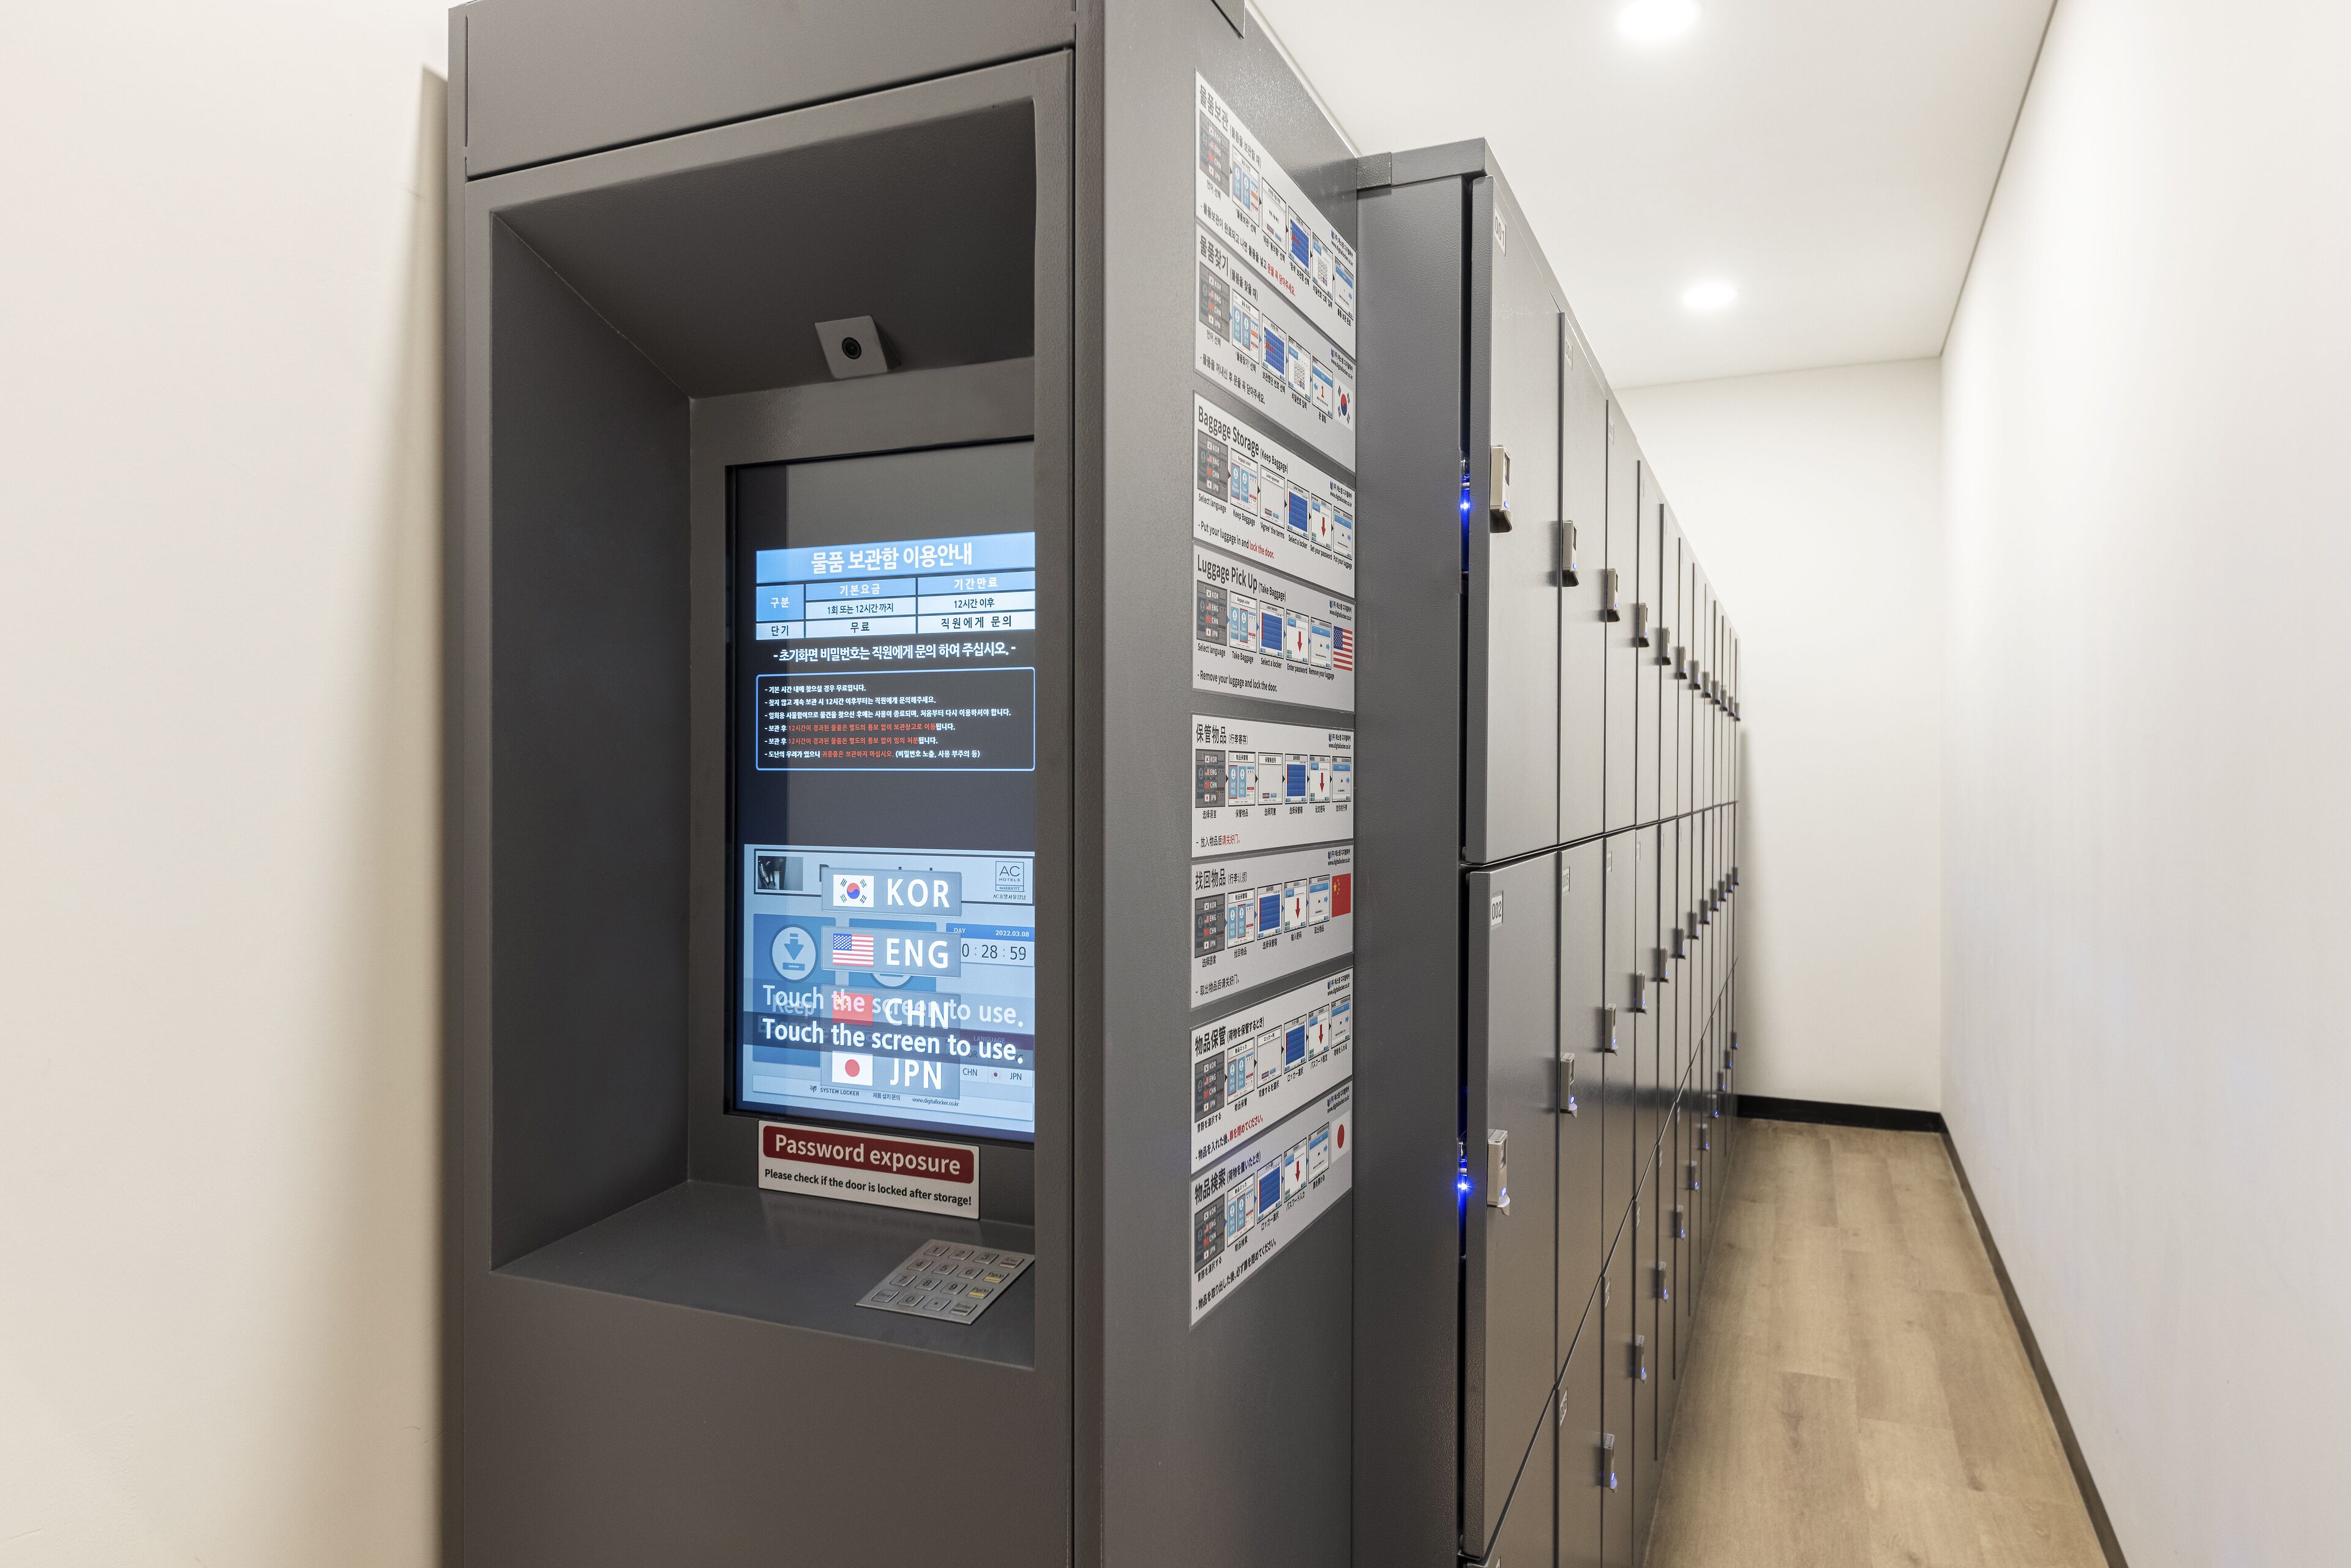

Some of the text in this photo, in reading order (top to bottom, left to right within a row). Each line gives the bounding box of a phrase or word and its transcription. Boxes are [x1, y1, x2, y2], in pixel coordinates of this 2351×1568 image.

[1200, 84, 1228, 132] 물품보관
[1495, 216, 1504, 246] 001
[1200, 235, 1228, 276] 물품찾기
[1199, 405, 1288, 474] Baggage Storage (Keep Baggage)
[1210, 526, 1219, 536] your
[1220, 528, 1236, 545] luggage
[1237, 535, 1240, 546] in
[1265, 547, 1274, 558] door.
[811, 542, 972, 574] 물품 보관함 이용안내
[839, 583, 880, 596] 기본요금
[954, 577, 998, 590] 기간만료
[1198, 554, 1286, 602] Luggage Pick Up (Take Baggage)
[770, 597, 790, 609] 구분
[827, 602, 893, 615] 1회 또는 12시간 까지
[954, 598, 995, 609] 12시간 이후
[771, 625, 789, 637] 단기
[850, 622, 870, 633] 무료
[941, 615, 1012, 629] 직원에게 문의
[820, 647, 870, 661] 비밀번호는
[872, 645, 913, 659] 직원에게
[915, 644, 936, 658] 문의
[939, 643, 960, 658] 하여
[962, 642, 1009, 656] 주십시오.
[1200, 670, 1217, 681] Remove
[1218, 675, 1228, 685] your
[1229, 675, 1244, 688] luggage
[1268, 683, 1277, 692] door.
[959, 708, 989, 717] 이용하셔야
[1196, 724, 1226, 745] 保管物品
[999, 865, 1020, 877] AC
[1196, 868, 1226, 891] 找回物品
[887, 878, 950, 908] KOR
[1491, 901, 1502, 920] 002
[886, 938, 948, 969] ENG
[763, 985, 823, 1009] Touch
[831, 989, 865, 1013] the
[948, 999, 970, 1020] to
[980, 1005, 1023, 1027] use.
[885, 998, 949, 1029] CHN
[762, 1018, 823, 1044] Touch
[831, 1023, 864, 1047] the
[872, 1032, 939, 1054] screen
[948, 1034, 970, 1056] to
[979, 1041, 1023, 1064] use.
[973, 1035, 1005, 1044] LANGUAGE
[1195, 1026, 1226, 1057] 物品保管
[890, 1058, 942, 1090] JPN
[962, 1068, 978, 1076] CHN
[775, 1134, 961, 1176] Password exposure
[765, 1168, 972, 1206] Please check if the door is locked after storage!
[1195, 1168, 1226, 1205] 物品検索
